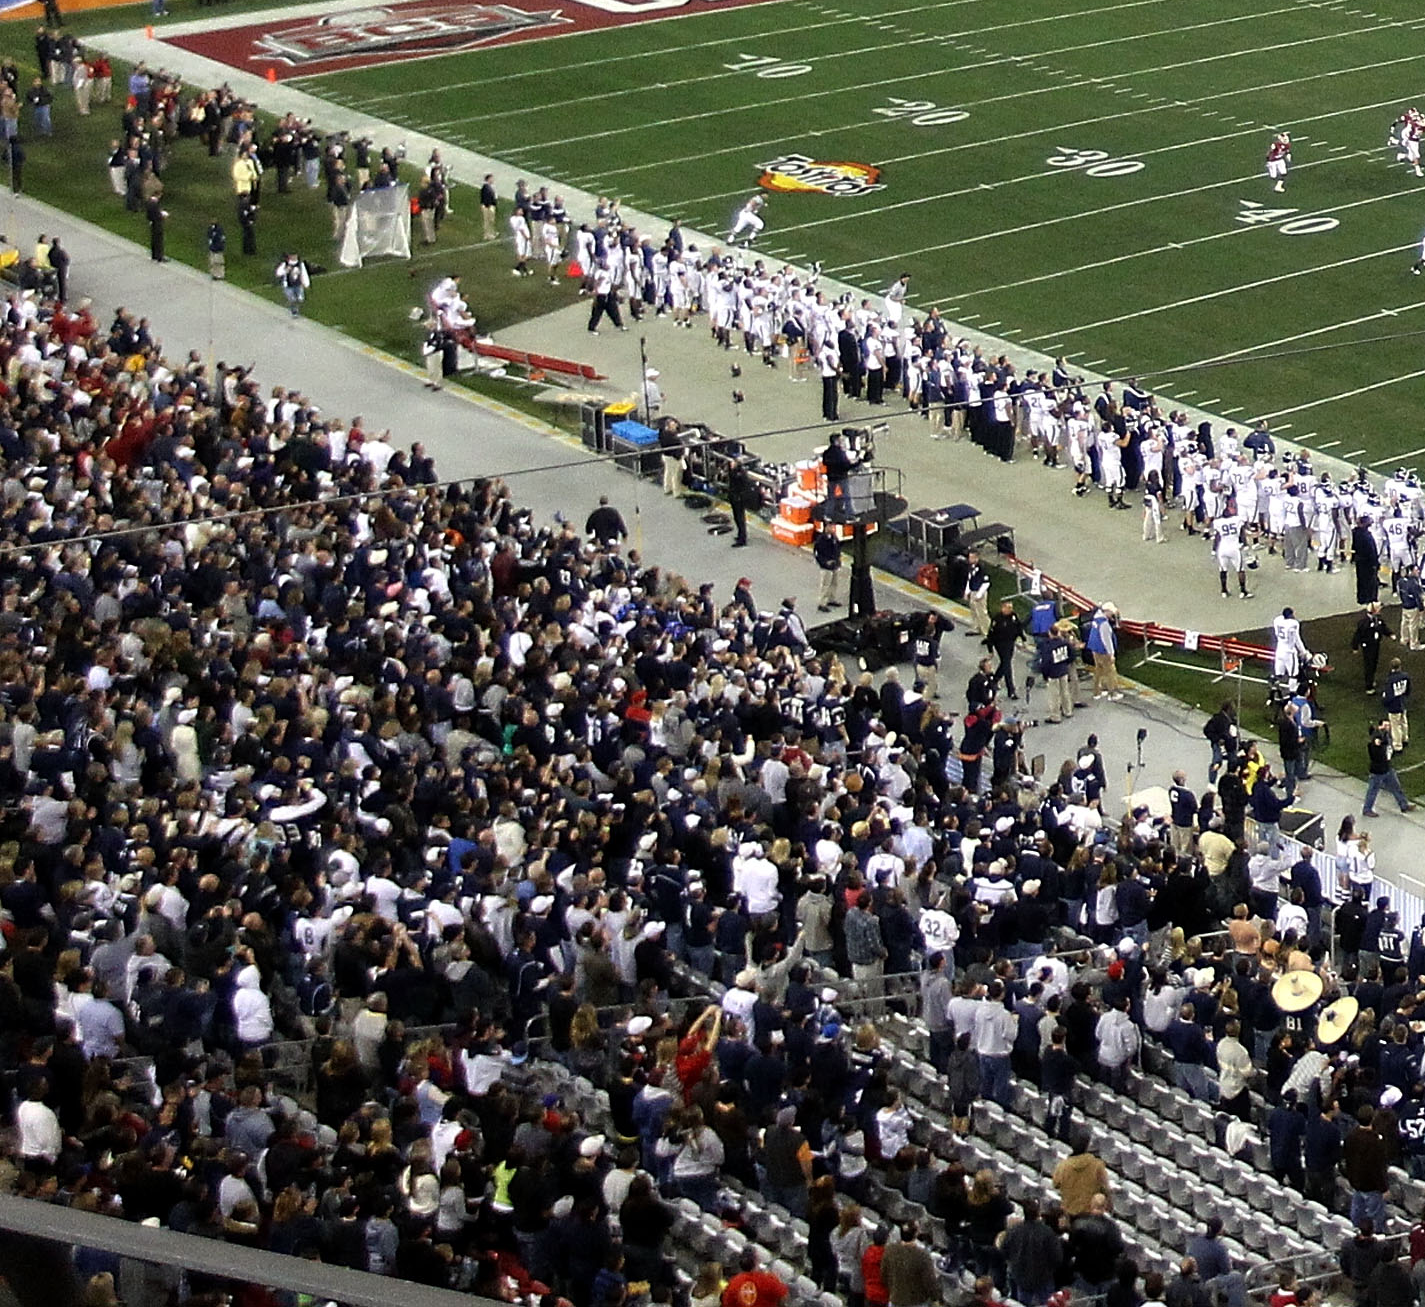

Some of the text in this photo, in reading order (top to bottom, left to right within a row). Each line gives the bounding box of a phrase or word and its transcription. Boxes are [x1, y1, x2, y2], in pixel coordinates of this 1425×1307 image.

[724, 53, 813, 79] 10
[872, 97, 971, 127] 20
[1046, 148, 1147, 179] 30
[1235, 201, 1342, 236] 40
[1221, 523, 1237, 537] 95
[1388, 523, 1403, 536] 46
[924, 918, 942, 938] 32
[1405, 1119, 1425, 1139] 52
